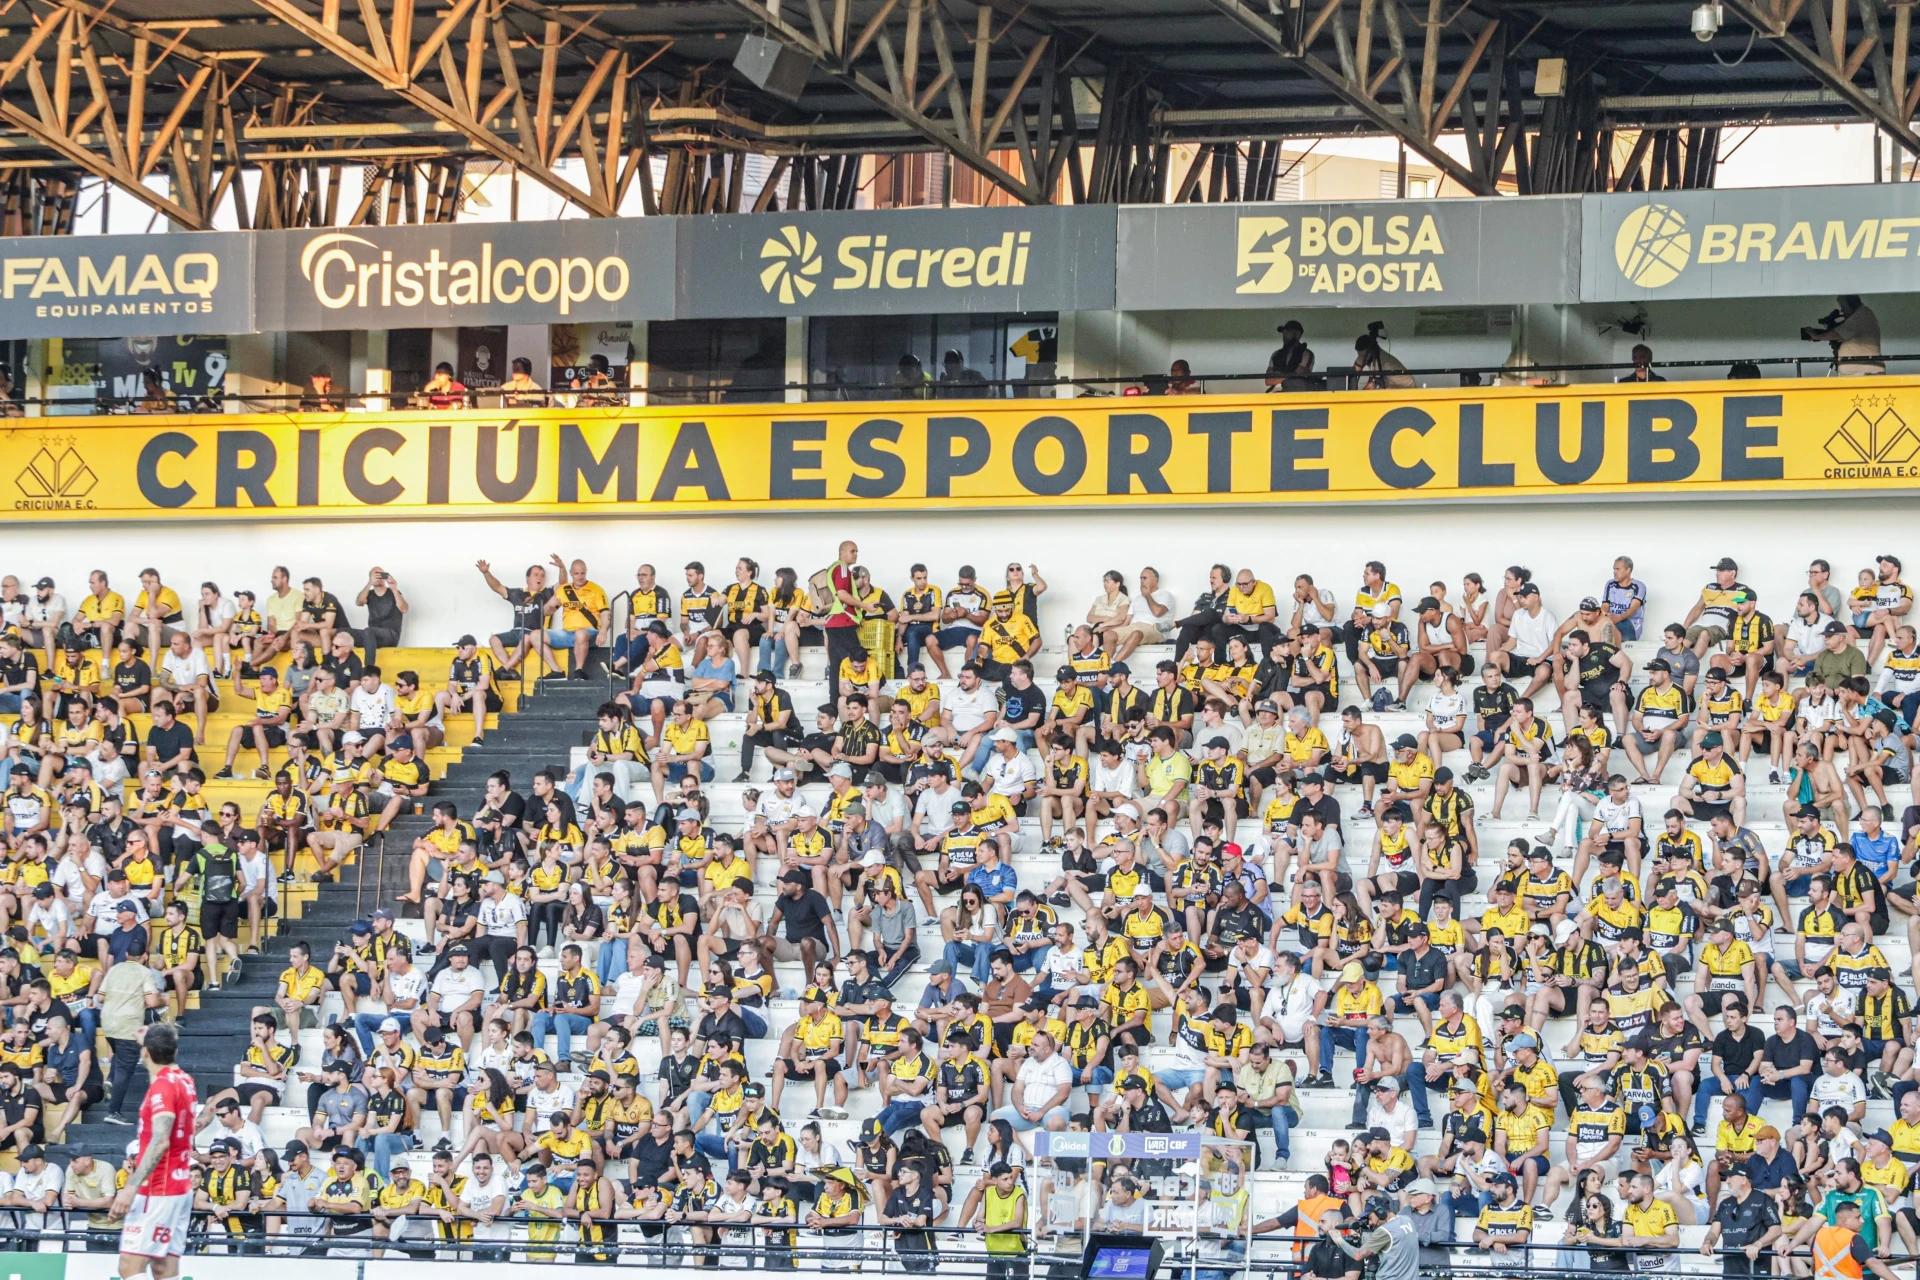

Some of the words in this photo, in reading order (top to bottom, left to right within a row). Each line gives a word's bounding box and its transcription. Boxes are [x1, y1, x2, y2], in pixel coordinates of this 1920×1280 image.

[1300, 215, 1445, 257] BOLSA
[1697, 217, 1920, 264] BRAME
[832, 231, 1030, 289] Sicredi
[0, 252, 219, 299] FAMAQ
[313, 242, 630, 315] Cristalcopo
[1299, 264, 1317, 277] DE
[1310, 262, 1443, 293] APOSTA
[36, 301, 213, 318] EQUIPAMENTOS
[136, 418, 732, 509] CRICIÚMA
[769, 408, 1330, 501] ESPORTE
[1368, 394, 1784, 490] CLUBE
[1824, 464, 1891, 478] CRICIÚMA
[1617, 1014, 1646, 1029] CAIXA
[1060, 1142, 1087, 1151] Midea
[1148, 1140, 1165, 1150] VAR
[1169, 1140, 1188, 1150] CBF
[733, 1231, 746, 1240] BET
[1399, 1223, 1413, 1233] TV
[1496, 1227, 1516, 1235] BOLSA
